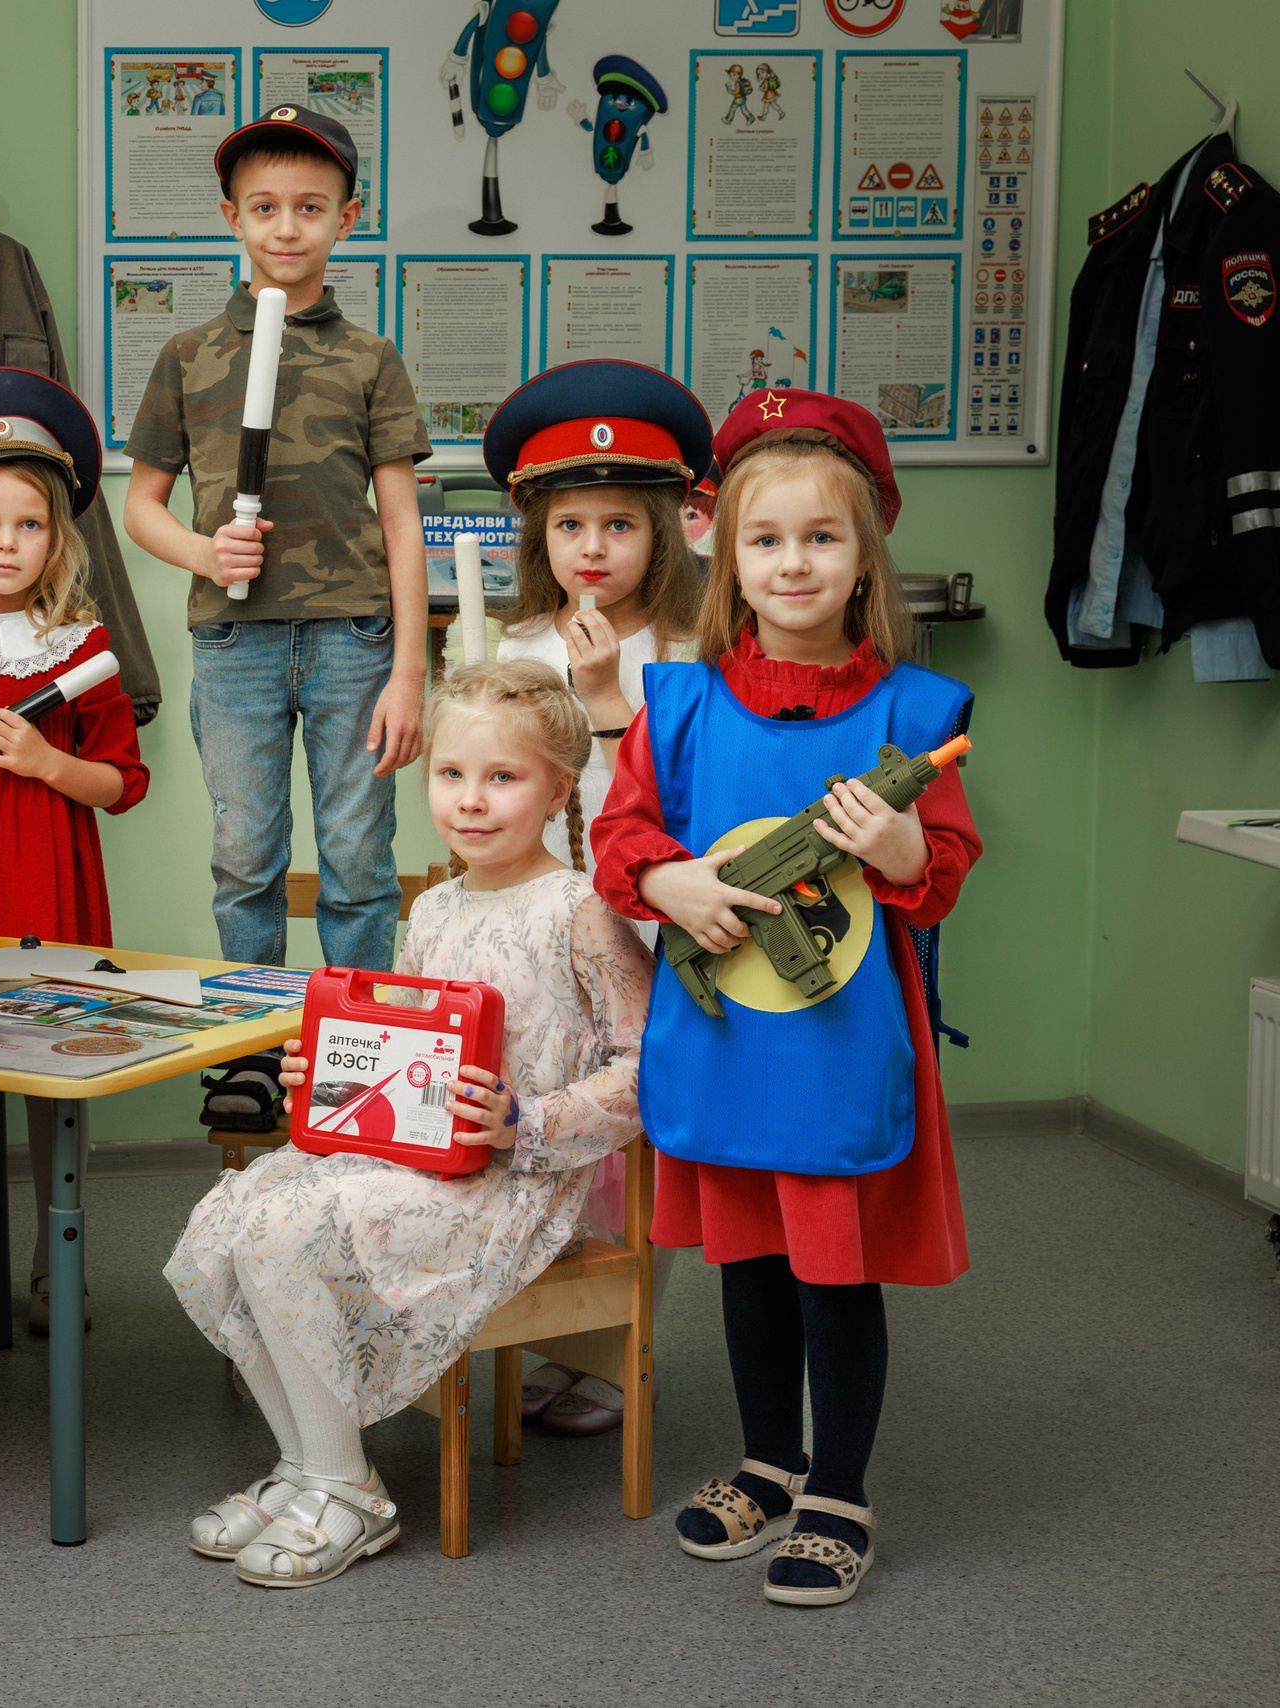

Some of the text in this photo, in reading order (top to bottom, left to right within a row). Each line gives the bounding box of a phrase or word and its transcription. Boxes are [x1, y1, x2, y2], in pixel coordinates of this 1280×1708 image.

[1225, 254, 1267, 270] ПОЛИЦИЯ
[1230, 270, 1269, 286] РОССИЯ
[1174, 290, 1200, 304] ДПС
[1247, 315, 1266, 327] МВД
[422, 516, 506, 530] ПРЕДЪЯВИ
[486, 550, 521, 560] ФЭС
[328, 1034, 382, 1050] аптечка
[327, 1050, 380, 1072] ФЭСТ
[415, 1052, 455, 1062] автомобильная
